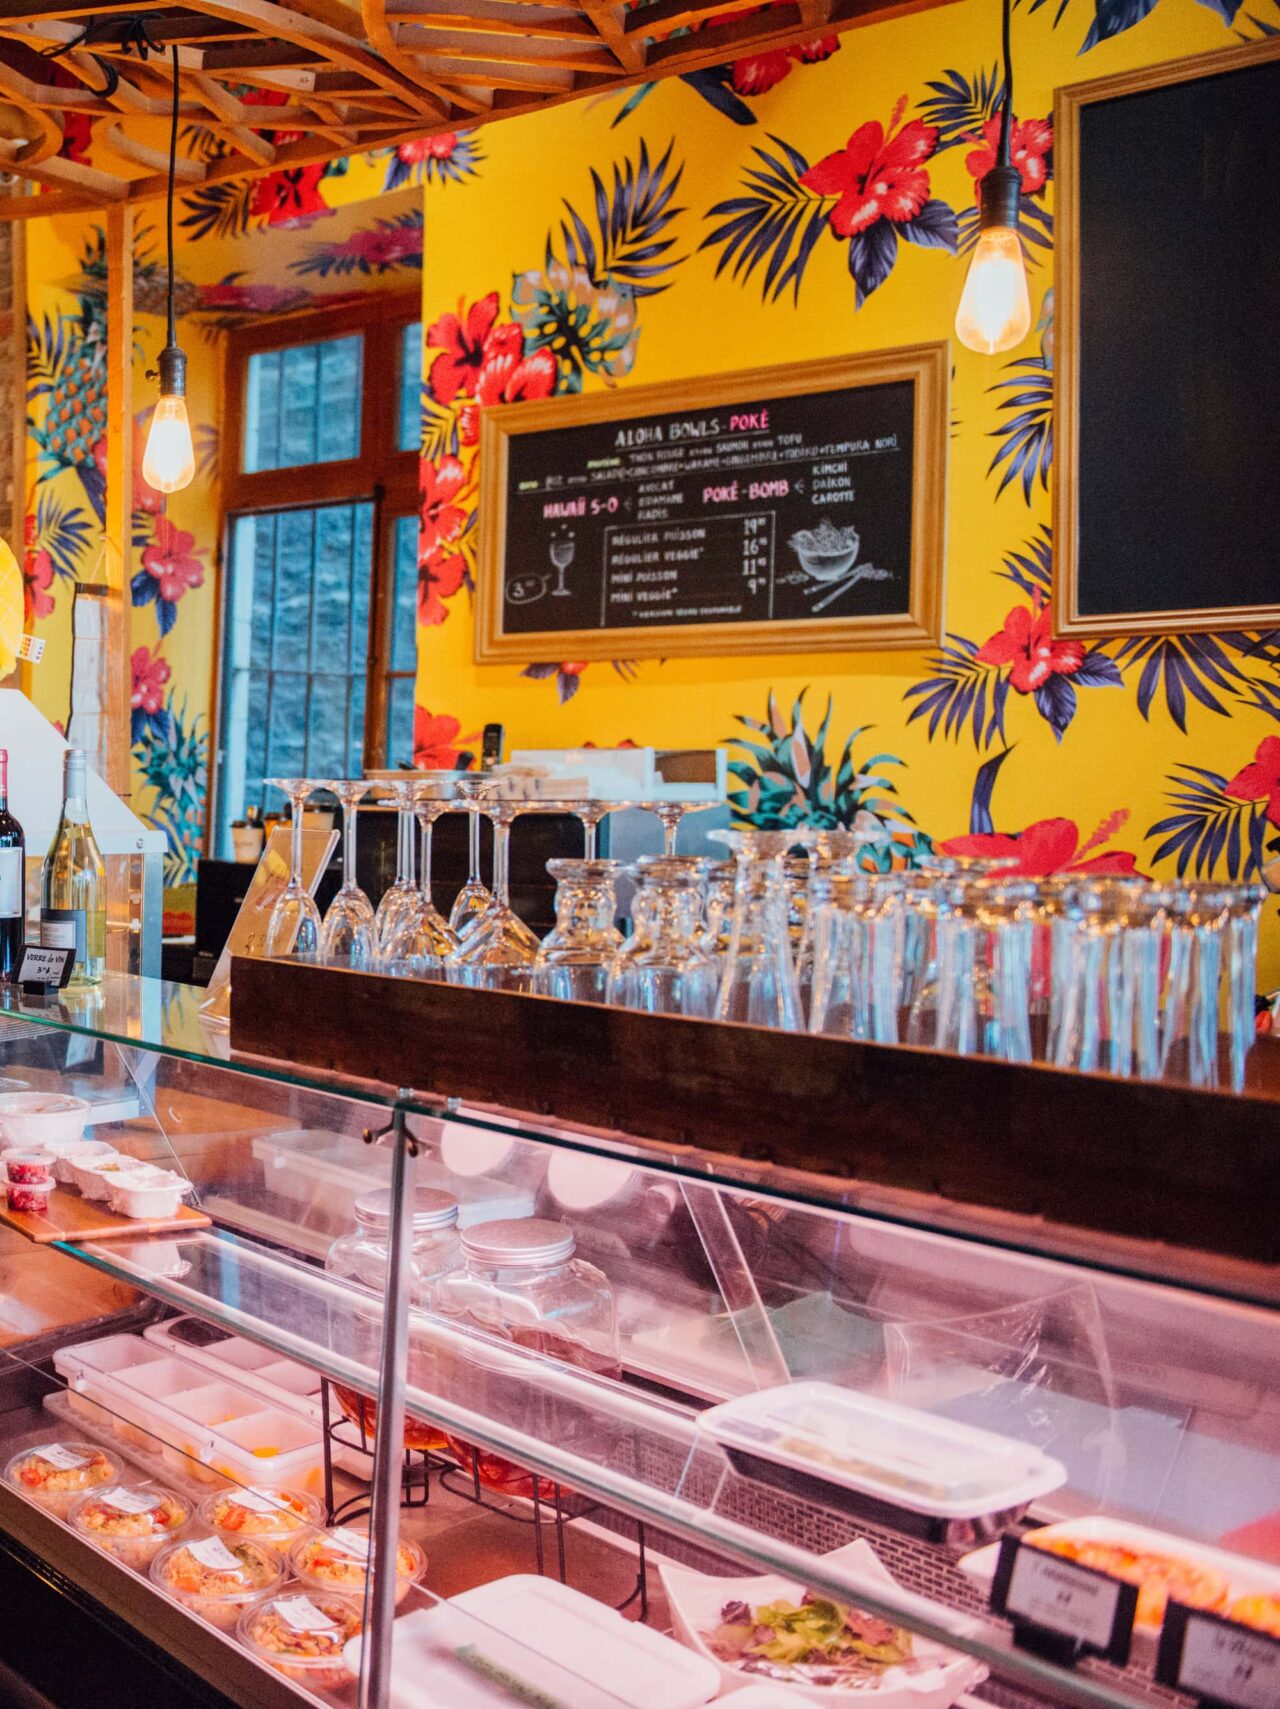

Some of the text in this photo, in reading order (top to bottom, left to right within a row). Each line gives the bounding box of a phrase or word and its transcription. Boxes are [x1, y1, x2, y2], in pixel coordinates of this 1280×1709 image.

[615, 408, 769, 447] ALOHA BOWLS POKÉ
[26, 953, 47, 962] VERRE
